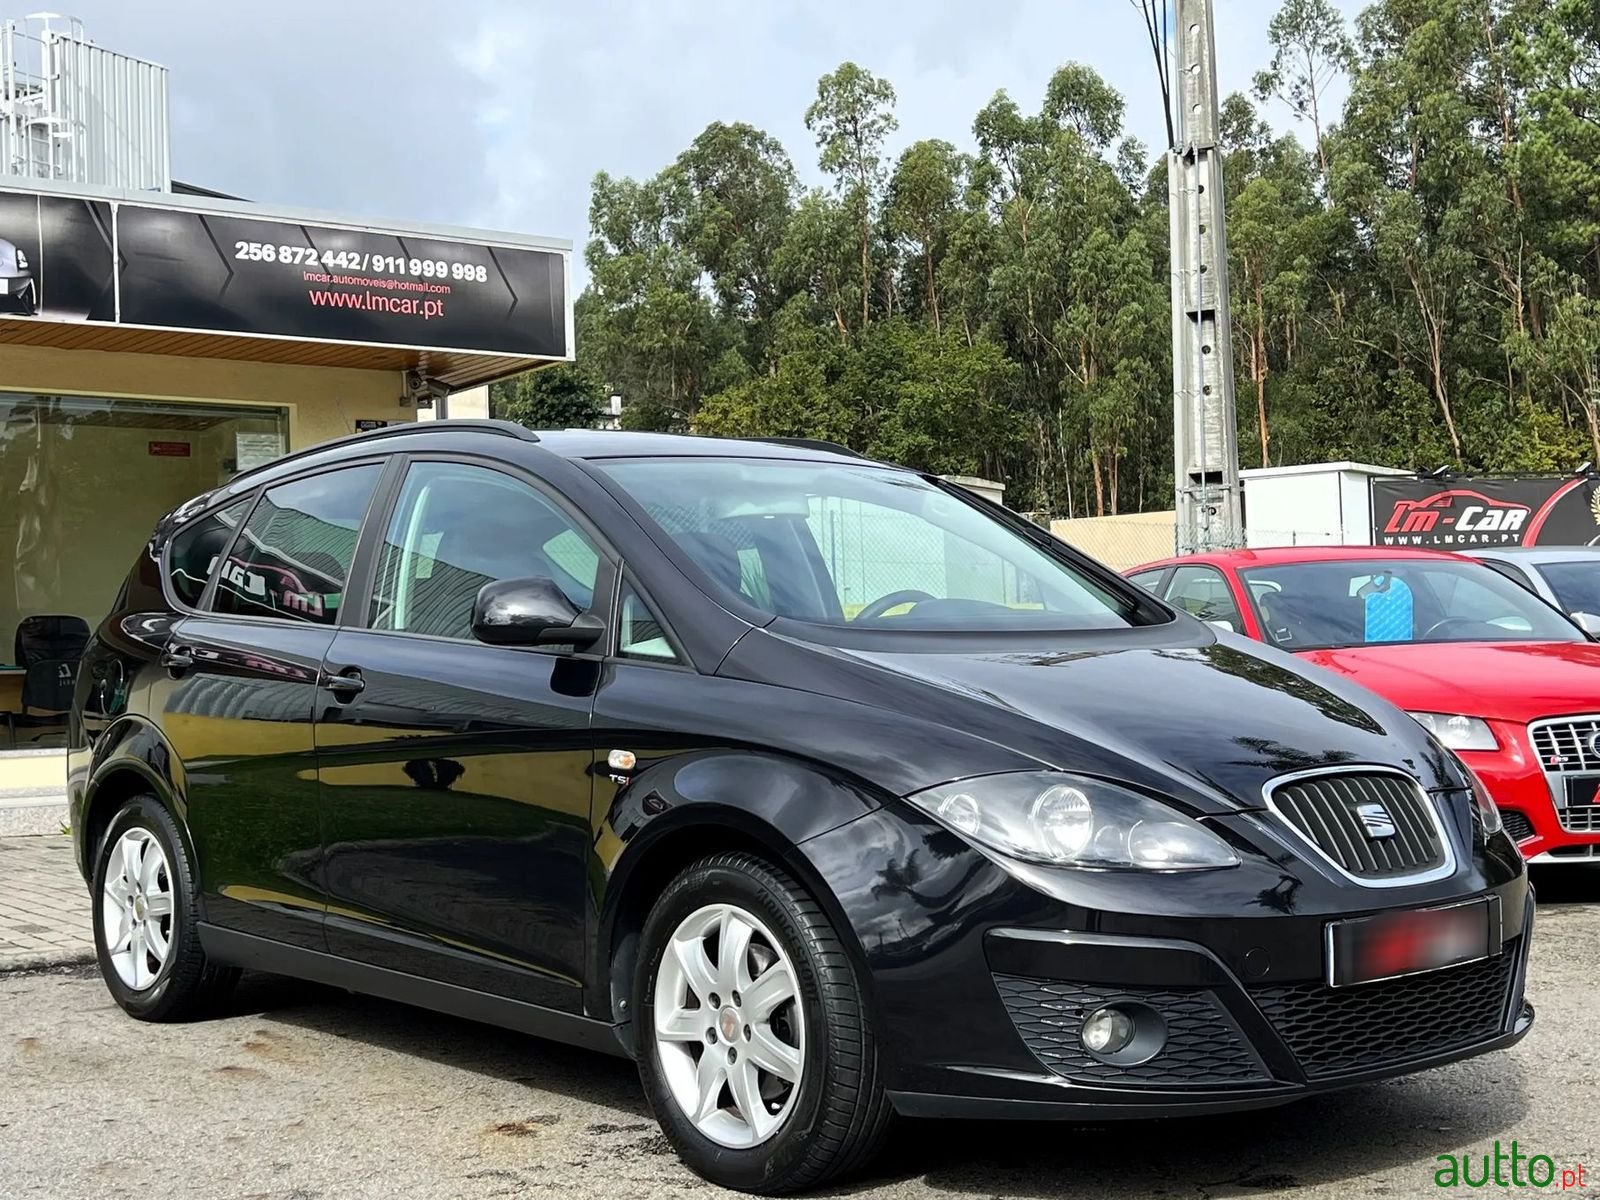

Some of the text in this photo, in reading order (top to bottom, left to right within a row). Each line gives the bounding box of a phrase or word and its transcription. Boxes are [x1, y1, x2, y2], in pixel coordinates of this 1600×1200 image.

[234, 241, 277, 262] 256
[278, 245, 319, 266] 872
[409, 258, 449, 278] 999
[451, 262, 488, 283] 998
[303, 270, 451, 294] lmcar.automoveis@hotmail.com
[308, 289, 444, 320] www.lmcar.pt
[1383, 533, 1520, 546] WWW.LMCAR.PT
[608, 773, 630, 786] TSI
